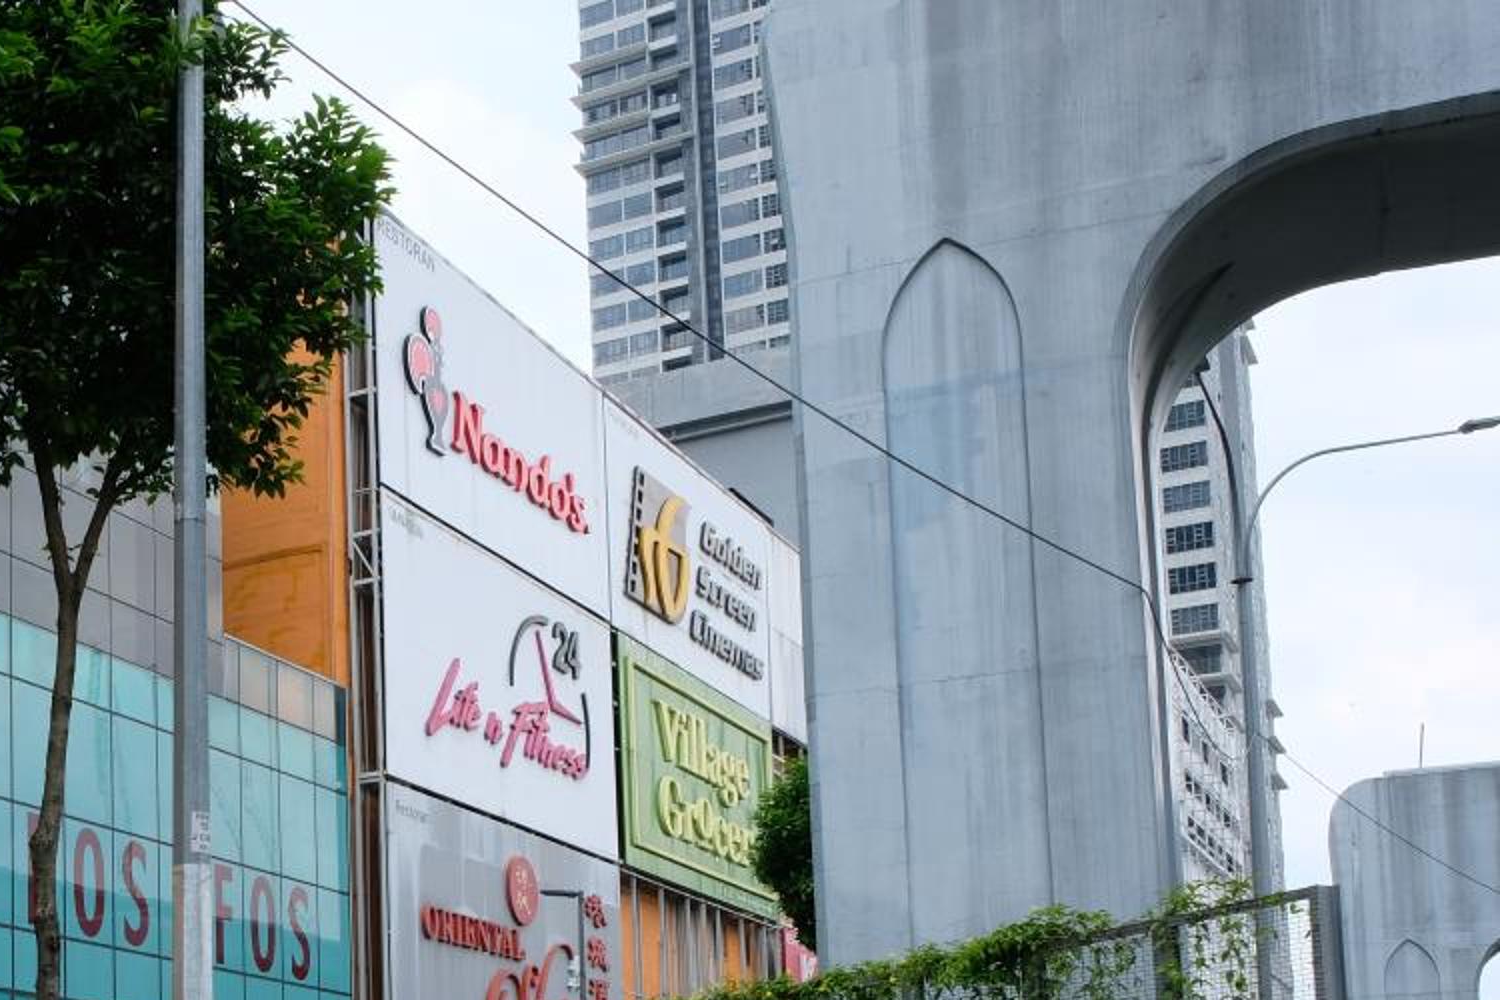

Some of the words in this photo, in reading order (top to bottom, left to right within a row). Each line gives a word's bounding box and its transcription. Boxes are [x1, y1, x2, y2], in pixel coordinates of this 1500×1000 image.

[450, 390, 589, 535] Nando's
[698, 519, 762, 594] Golden
[694, 564, 758, 634] Screen
[550, 622, 581, 681] 24
[688, 609, 765, 681] Cinemas
[425, 657, 484, 737] Life
[483, 708, 505, 746] n
[500, 701, 590, 781] Fitness
[653, 699, 751, 809] Village
[657, 776, 757, 868] Grocer
[213, 863, 311, 982] FOS
[420, 902, 527, 962] ORIENTAL
